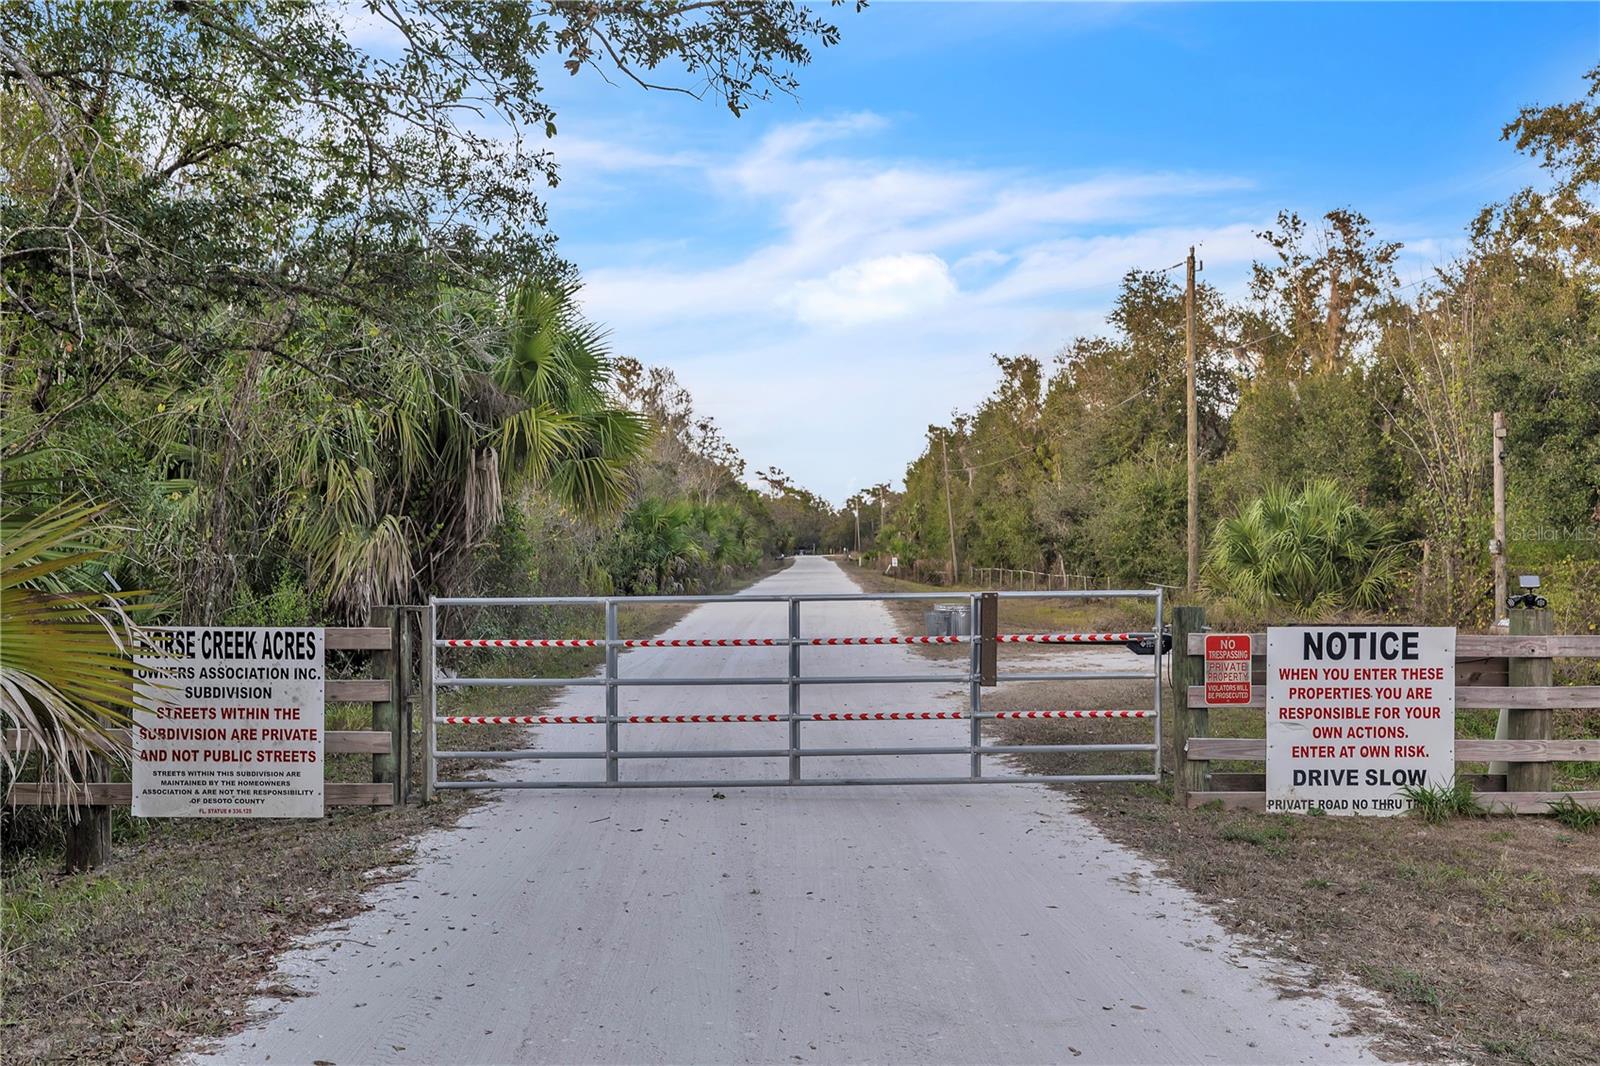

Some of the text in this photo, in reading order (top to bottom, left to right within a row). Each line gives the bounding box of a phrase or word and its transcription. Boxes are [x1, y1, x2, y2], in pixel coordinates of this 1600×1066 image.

[202, 631, 257, 659] CREEK
[262, 631, 315, 660] ACRES
[1220, 640, 1235, 649] NO
[1304, 632, 1418, 660] NOTICE
[1208, 651, 1248, 659] TRESPASSING
[1209, 663, 1247, 671] PRIVATE
[199, 667, 289, 679] ASSOCIATION
[294, 668, 320, 680] INC.
[1208, 672, 1249, 681] PROPERTY
[1279, 668, 1443, 680] WHEN YOU ENTER THESE
[185, 687, 271, 699] SUBDIVISION
[1290, 688, 1432, 699] PROPERTIES YOU ARE
[156, 707, 300, 720] STREETS WITHIN THE
[1280, 707, 1440, 719] RESPONSIBLE FOR YOUR
[140, 727, 317, 740] SUBDIVISION ARE PRIVATE
[1313, 727, 1408, 738] OWN ACTIONS.
[138, 750, 316, 762] AND NOT PUBLIC STREETS
[1292, 746, 1428, 757] ENTER AT OWN RISK.
[1293, 769, 1426, 787] DRIVE SLOW
[1268, 799, 1314, 811] PRIVATE
[1318, 799, 1348, 810] ROAD
[1352, 799, 1368, 810] NO
[1372, 799, 1402, 810] THRU
